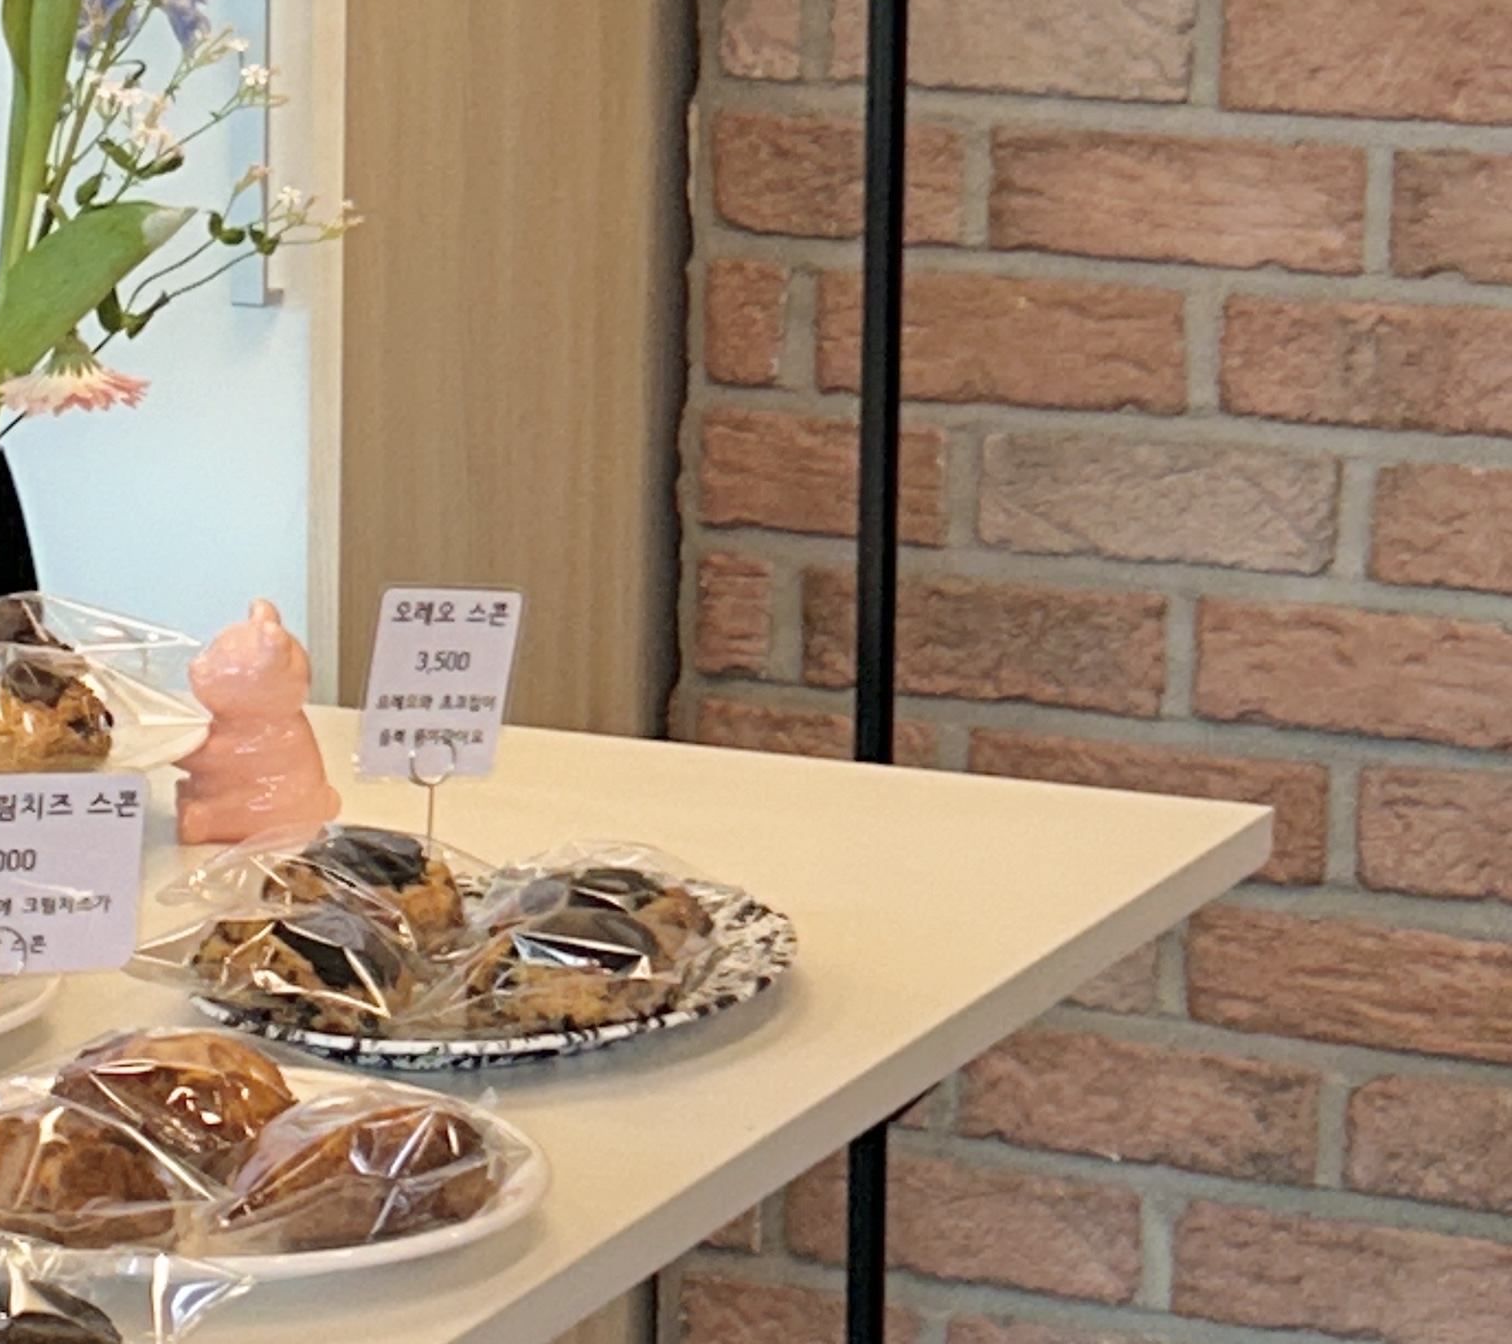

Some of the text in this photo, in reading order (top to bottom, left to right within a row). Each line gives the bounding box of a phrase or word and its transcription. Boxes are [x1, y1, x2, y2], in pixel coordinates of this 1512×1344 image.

[391, 600, 509, 628] 오레오 스콘
[415, 650, 471, 674] 3,500
[86, 789, 141, 818] 스콘
